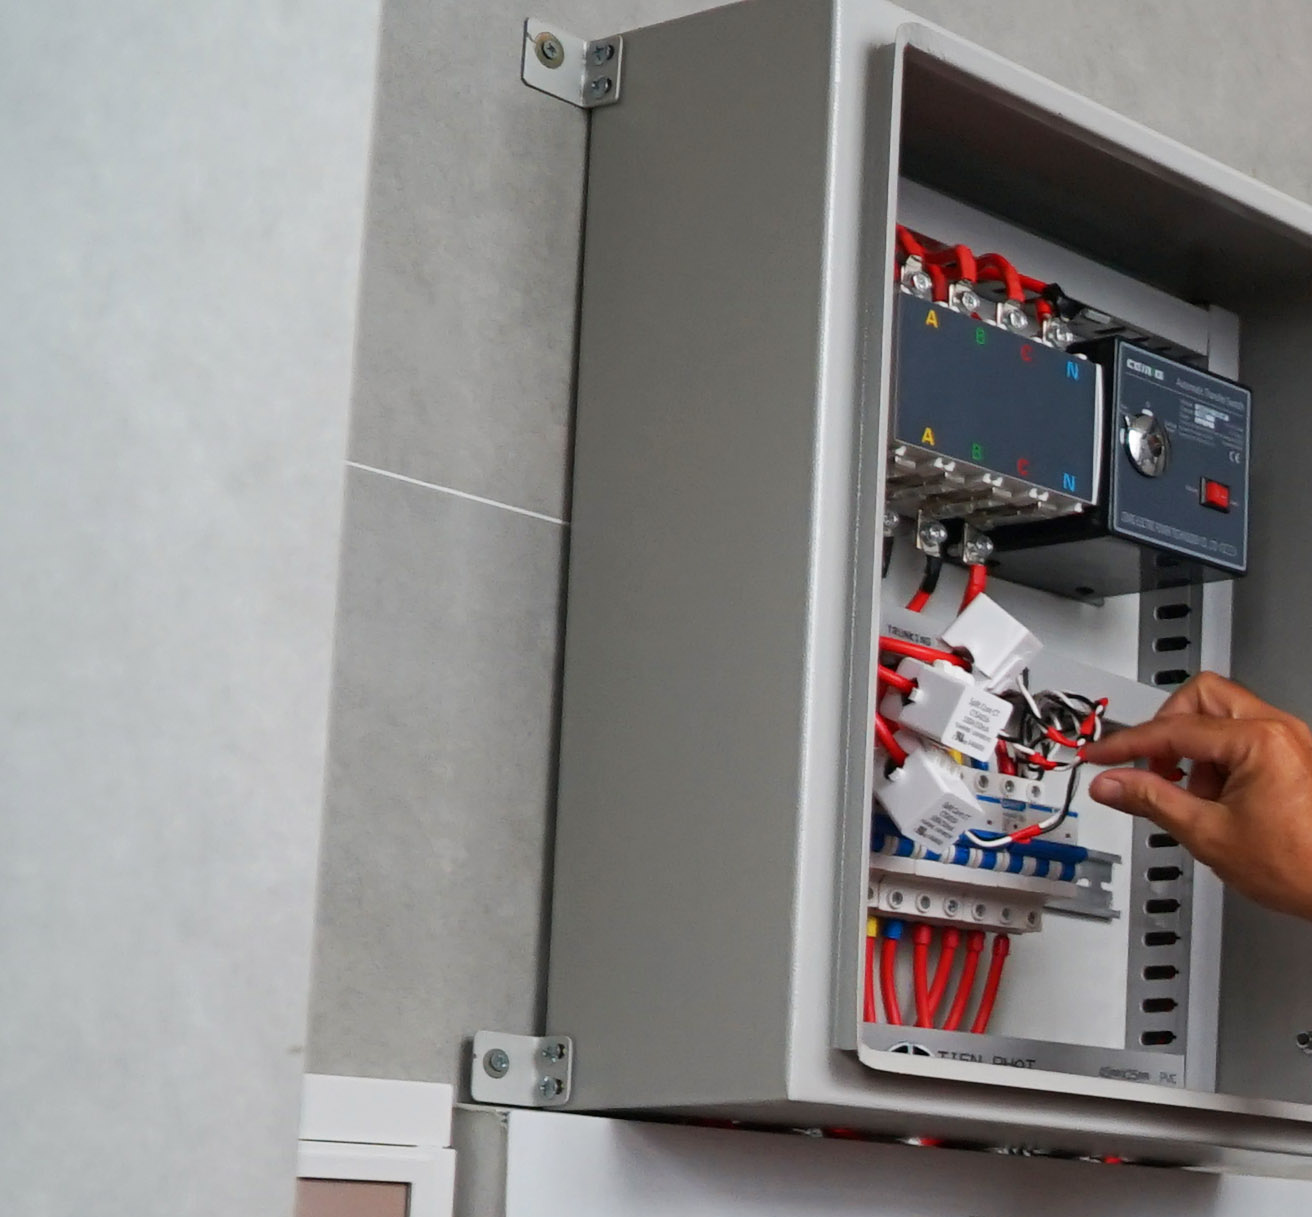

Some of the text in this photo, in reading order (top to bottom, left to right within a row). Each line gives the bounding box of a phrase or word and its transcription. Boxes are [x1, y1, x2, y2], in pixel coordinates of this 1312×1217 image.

[925, 310, 1079, 381] A B C N
[921, 427, 1076, 492] A B C N
